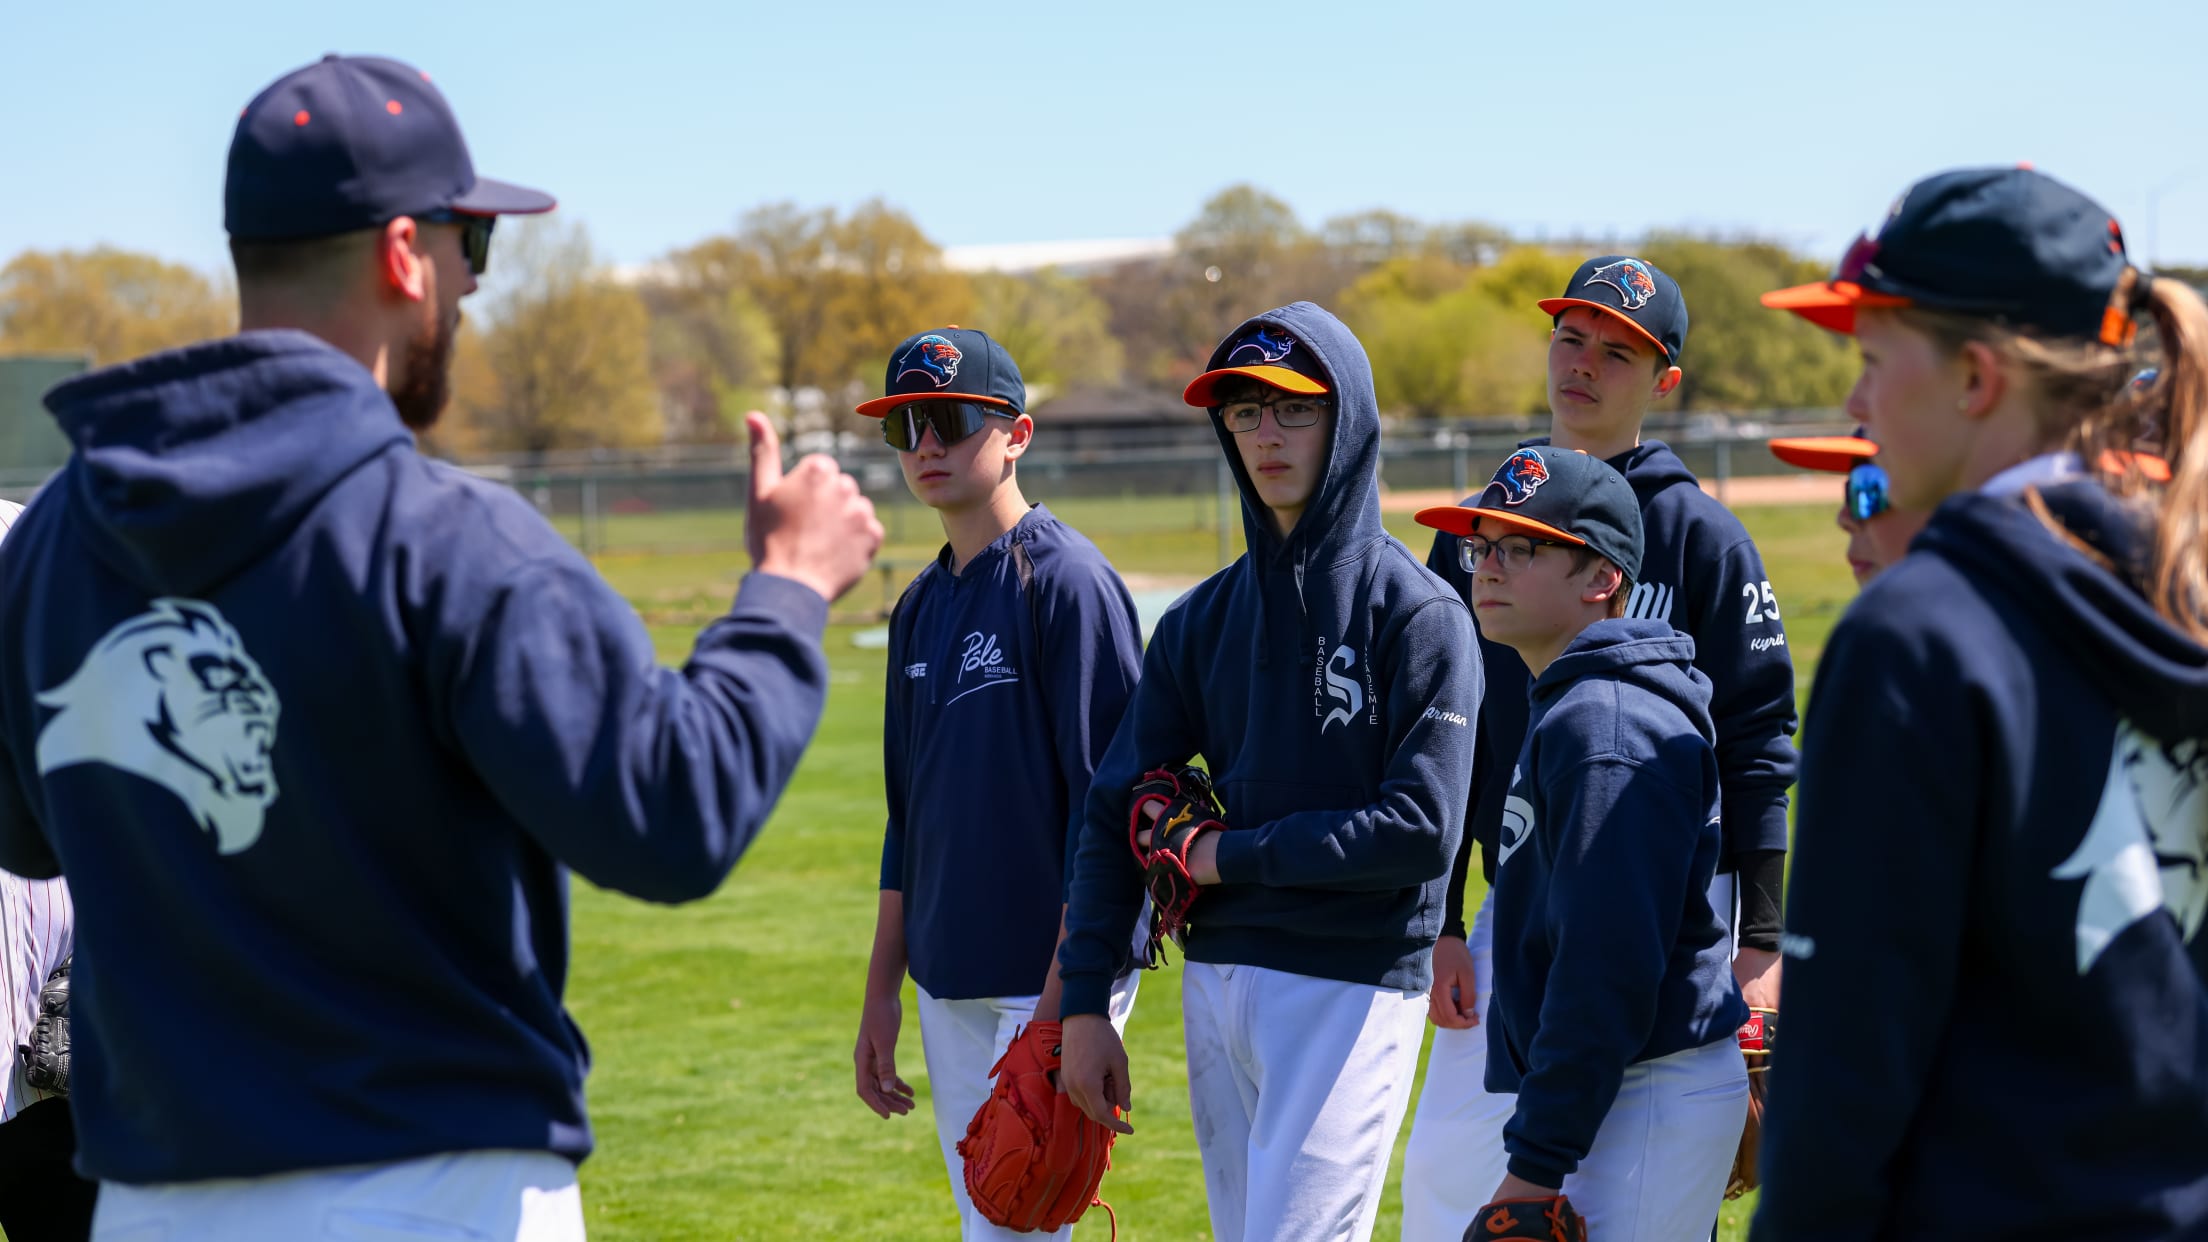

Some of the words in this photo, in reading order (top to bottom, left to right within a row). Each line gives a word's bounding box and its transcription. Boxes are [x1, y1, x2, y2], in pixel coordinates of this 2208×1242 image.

[1742, 581, 1780, 624] 25
[958, 632, 1003, 684] Pôle
[984, 666, 1018, 675] BASEBALL
[1314, 636, 1326, 717] BASEBALL
[1321, 644, 1363, 735] S
